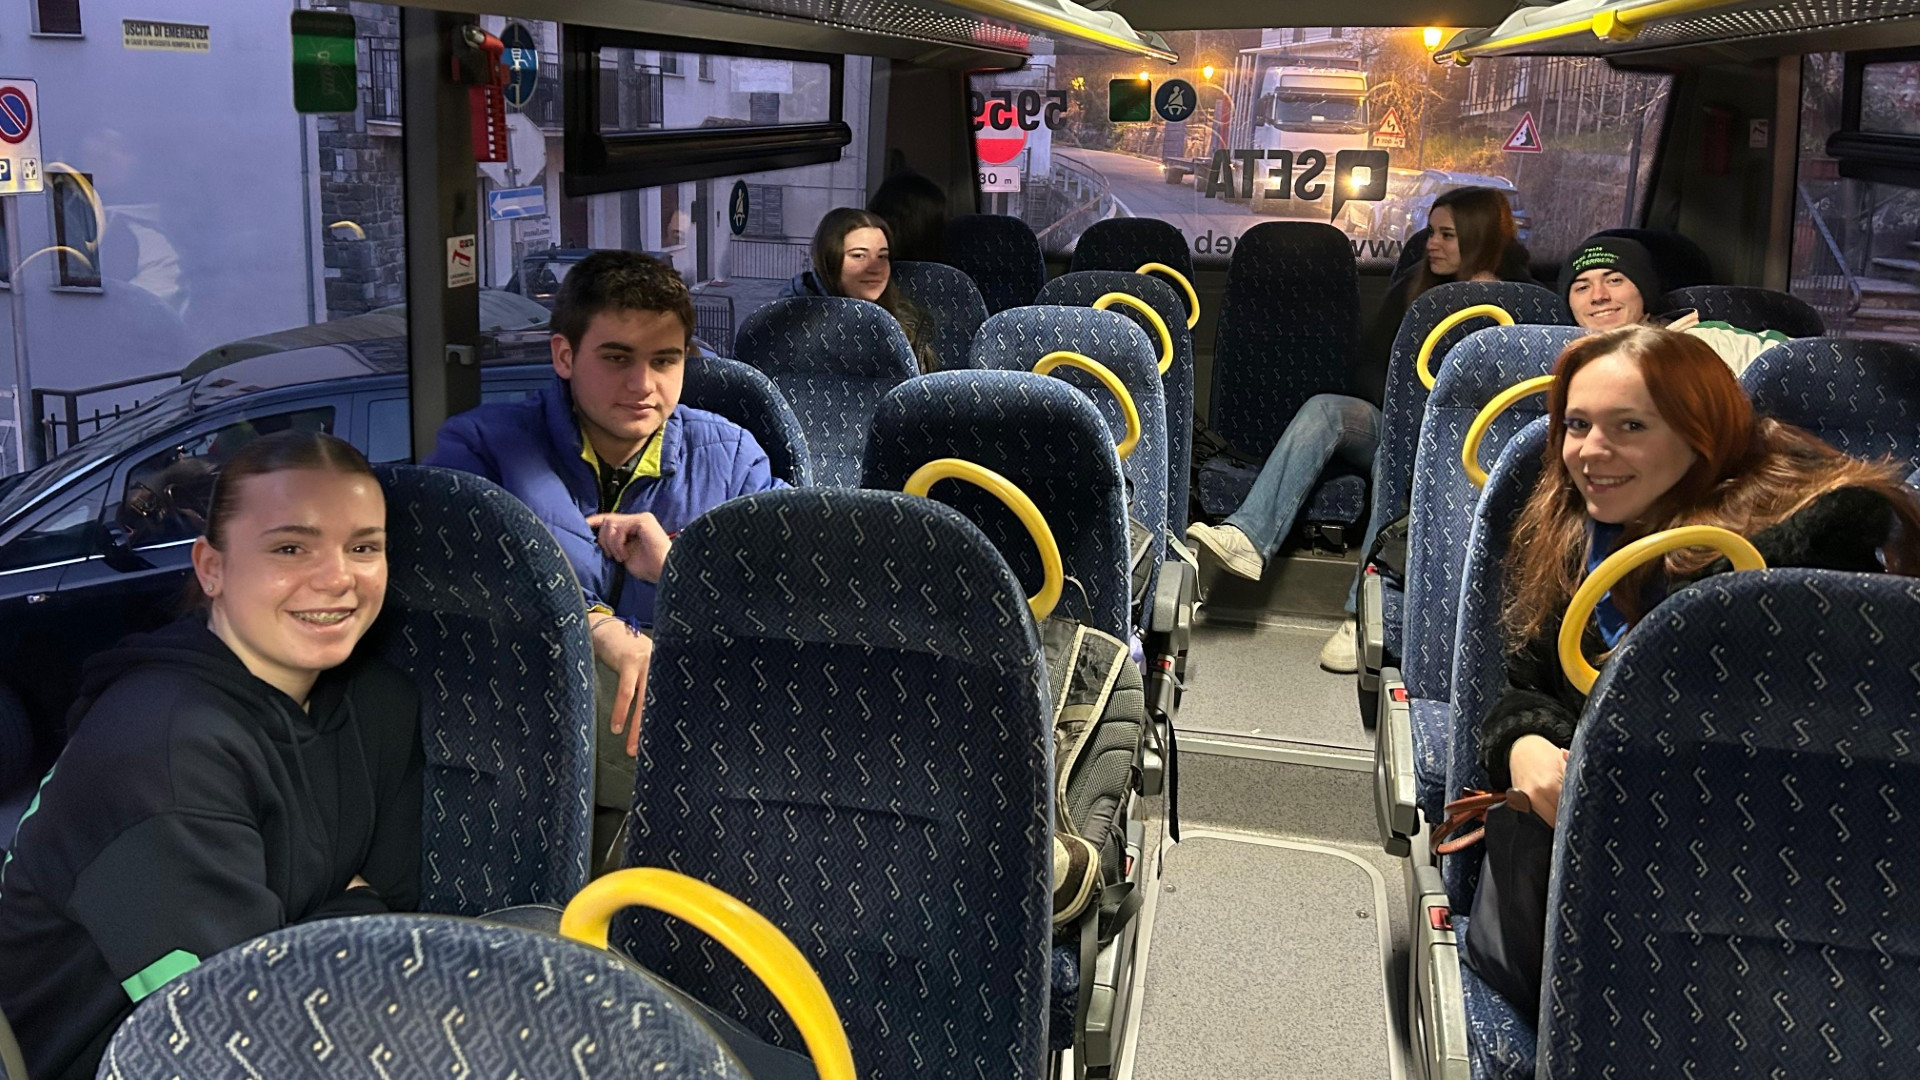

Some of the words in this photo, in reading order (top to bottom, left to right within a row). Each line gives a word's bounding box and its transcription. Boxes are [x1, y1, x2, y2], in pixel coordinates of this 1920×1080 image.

[125, 23, 152, 36] USCITA
[154, 25, 163, 37] DI
[165, 26, 208, 39] EMERGENZA
